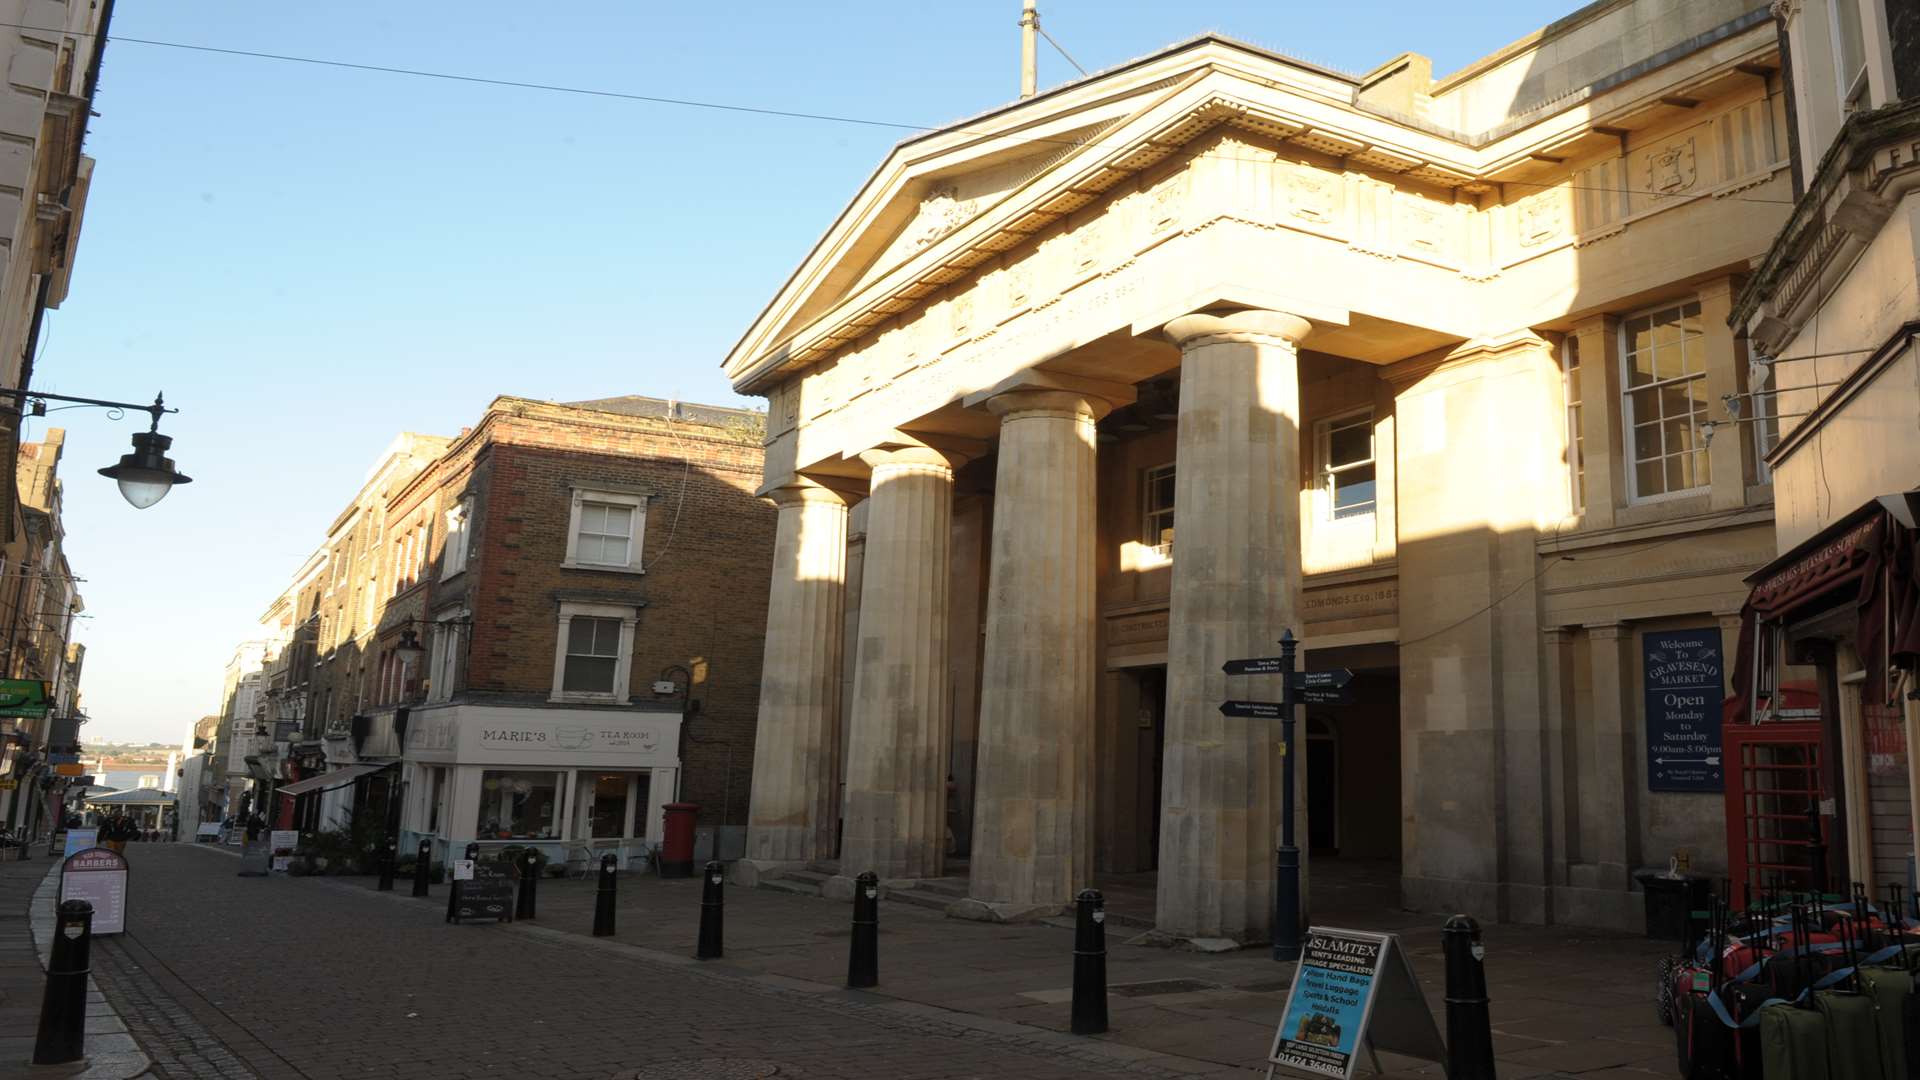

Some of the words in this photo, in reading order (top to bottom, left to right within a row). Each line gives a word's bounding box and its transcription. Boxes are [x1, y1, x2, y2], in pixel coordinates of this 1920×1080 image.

[1660, 640, 1704, 650] Welcome
[1675, 650, 1689, 659] To
[1649, 661, 1718, 680] GRAVESEND
[1660, 674, 1706, 685] MARKET
[1664, 694, 1705, 709] Open
[1664, 711, 1705, 721] Monday
[1680, 723, 1692, 731] to
[482, 730, 547, 742] MARIE'S
[600, 730, 622, 739] TEA
[622, 730, 650, 740] ROOM
[1663, 732, 1708, 743] Saturday
[72, 859, 119, 868] BARBERS
[1333, 953, 1366, 965] LEADING
[1329, 962, 1375, 975] SPECIALISTS
[1326, 971, 1347, 982] Hand
[1349, 975, 1370, 986] Bags
[1324, 983, 1360, 995] Luggage
[1330, 995, 1359, 1007] School
[1277, 1052, 1306, 1066] 01474
